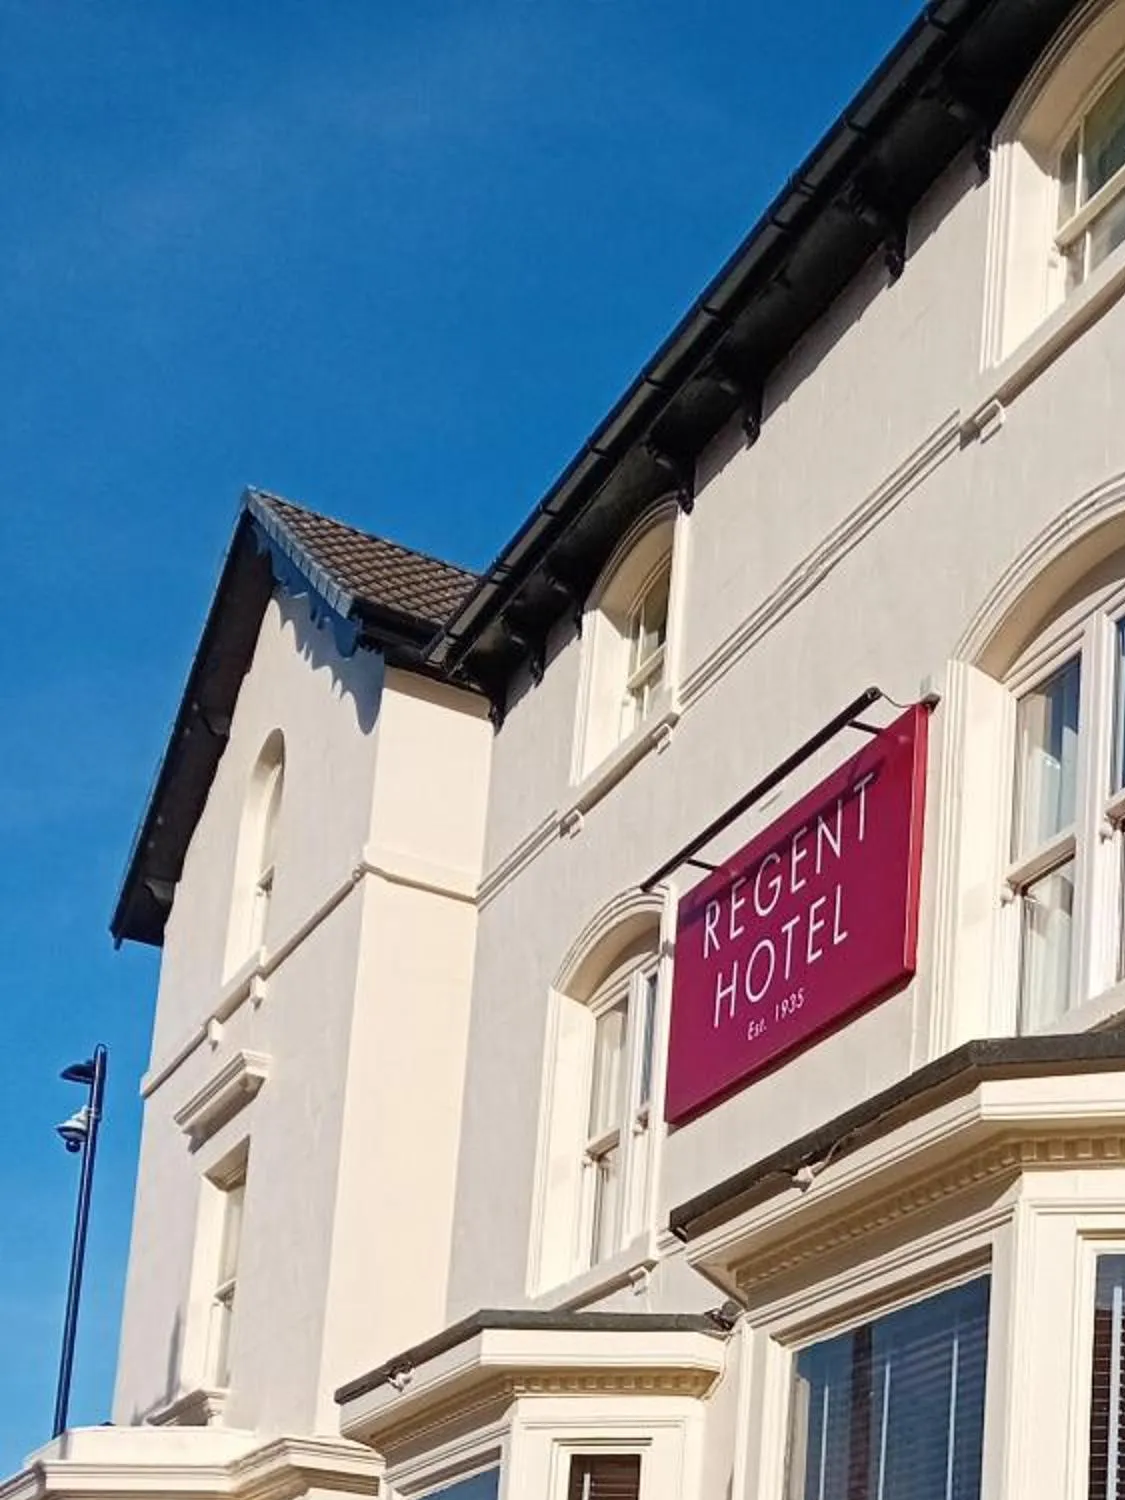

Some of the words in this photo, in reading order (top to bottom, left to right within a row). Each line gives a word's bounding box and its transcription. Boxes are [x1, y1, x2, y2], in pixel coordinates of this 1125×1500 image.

[703, 772, 876, 959] REGENT
[713, 883, 849, 1028] HOTEL
[775, 987, 805, 1022] 1935
